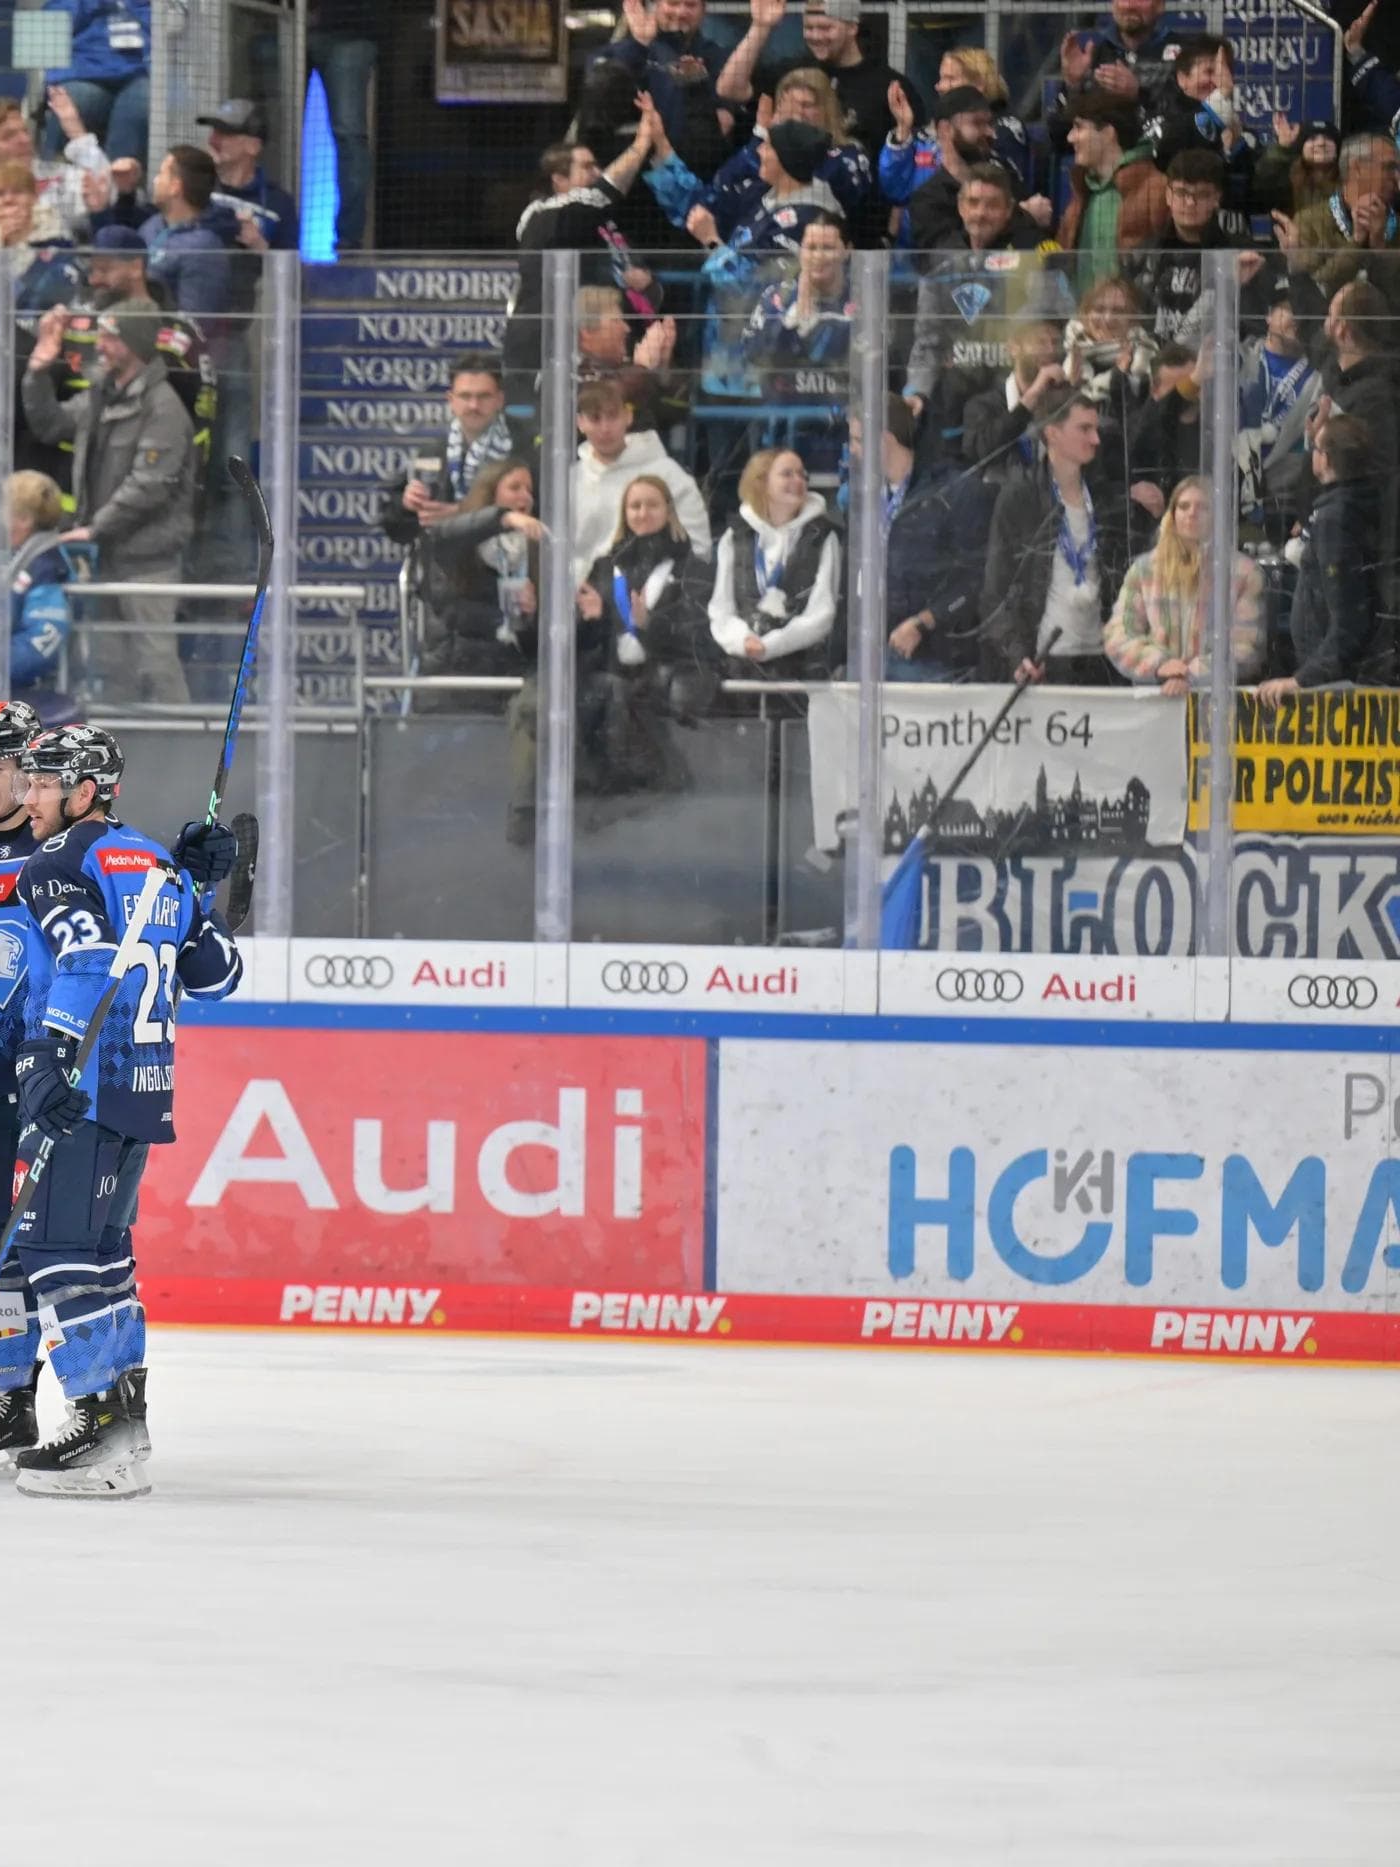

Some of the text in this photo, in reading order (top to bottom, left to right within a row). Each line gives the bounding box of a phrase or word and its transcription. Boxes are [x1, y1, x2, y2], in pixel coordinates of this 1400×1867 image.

[1045, 710, 1094, 748] 64
[52, 910, 102, 950] 23
[411, 960, 507, 989] Audi
[705, 966, 799, 995] Audi
[1041, 973, 1137, 1002] Audi
[1343, 1072, 1400, 1141] P
[186, 1078, 644, 1219] Audi
